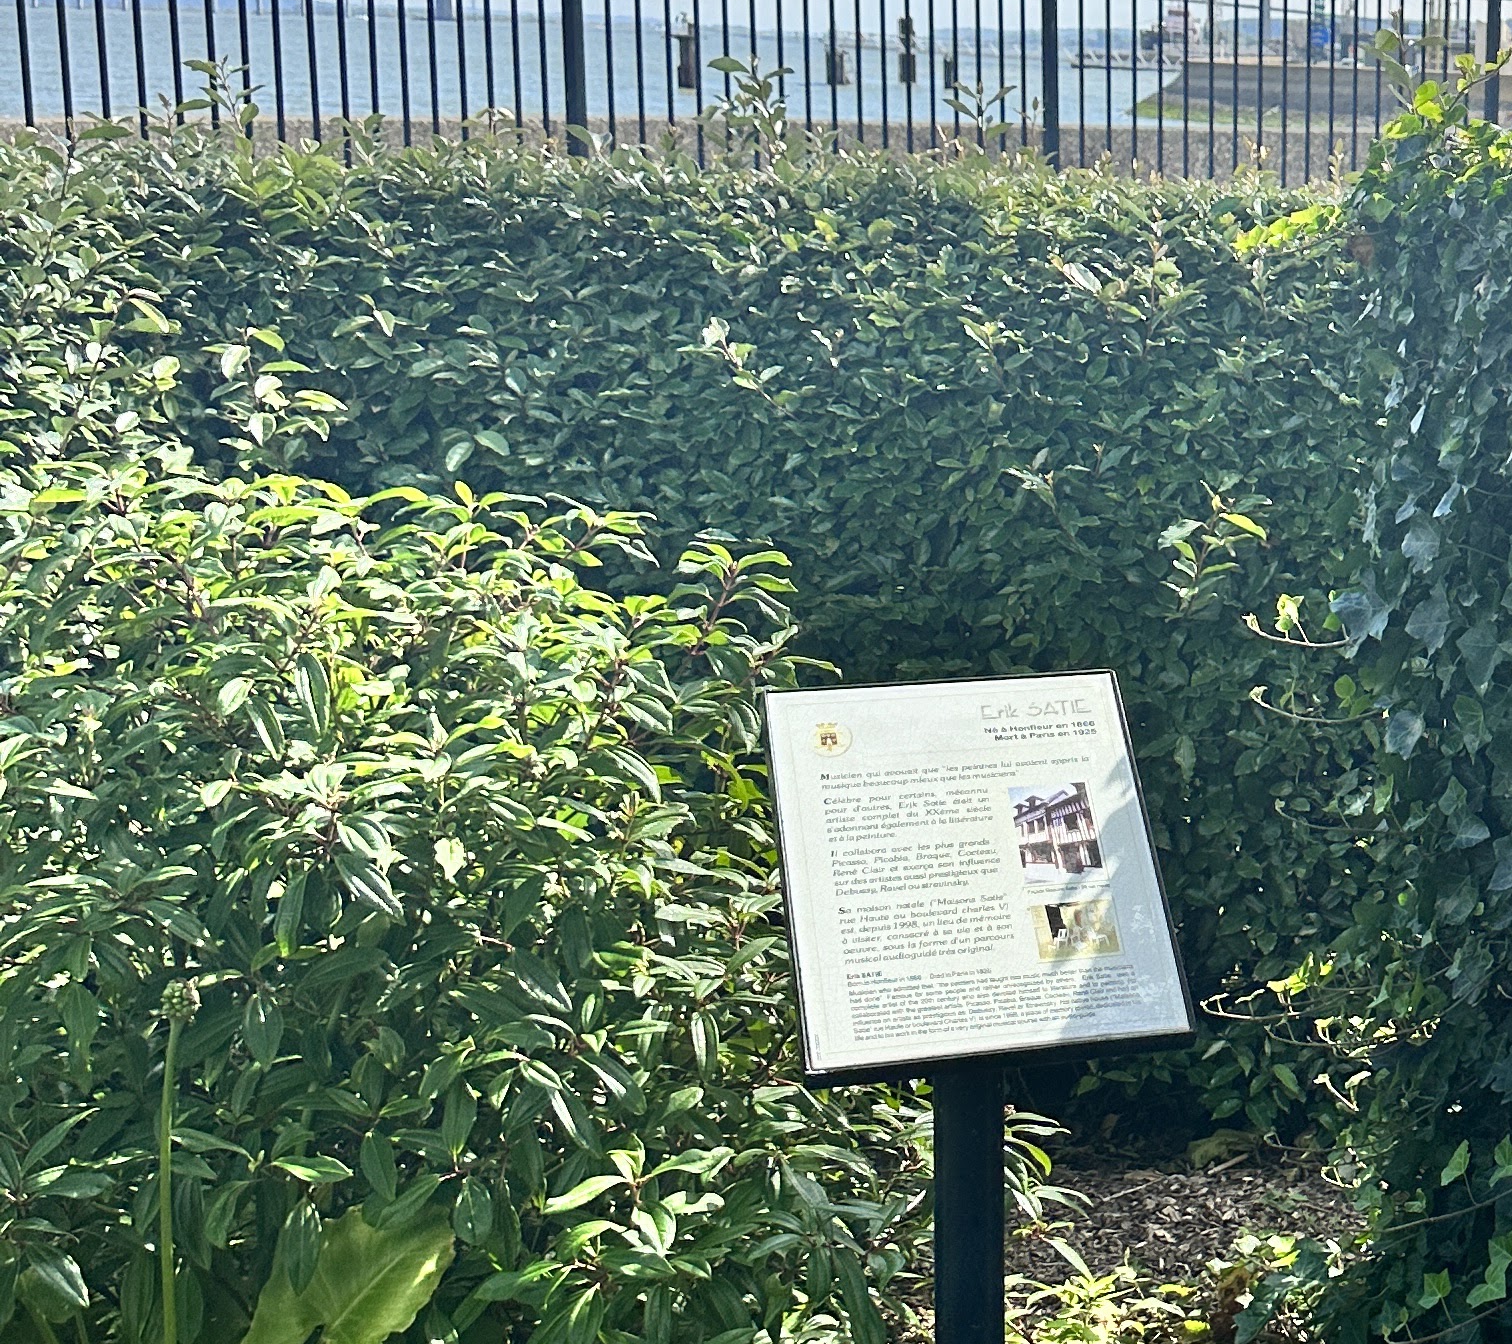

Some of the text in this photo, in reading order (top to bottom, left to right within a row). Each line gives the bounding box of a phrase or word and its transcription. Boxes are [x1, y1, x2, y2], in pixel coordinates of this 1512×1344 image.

[979, 698, 1092, 720] Erik SATIE
[1009, 723, 1053, 731] Honfleur
[994, 733, 1018, 741] Mort
